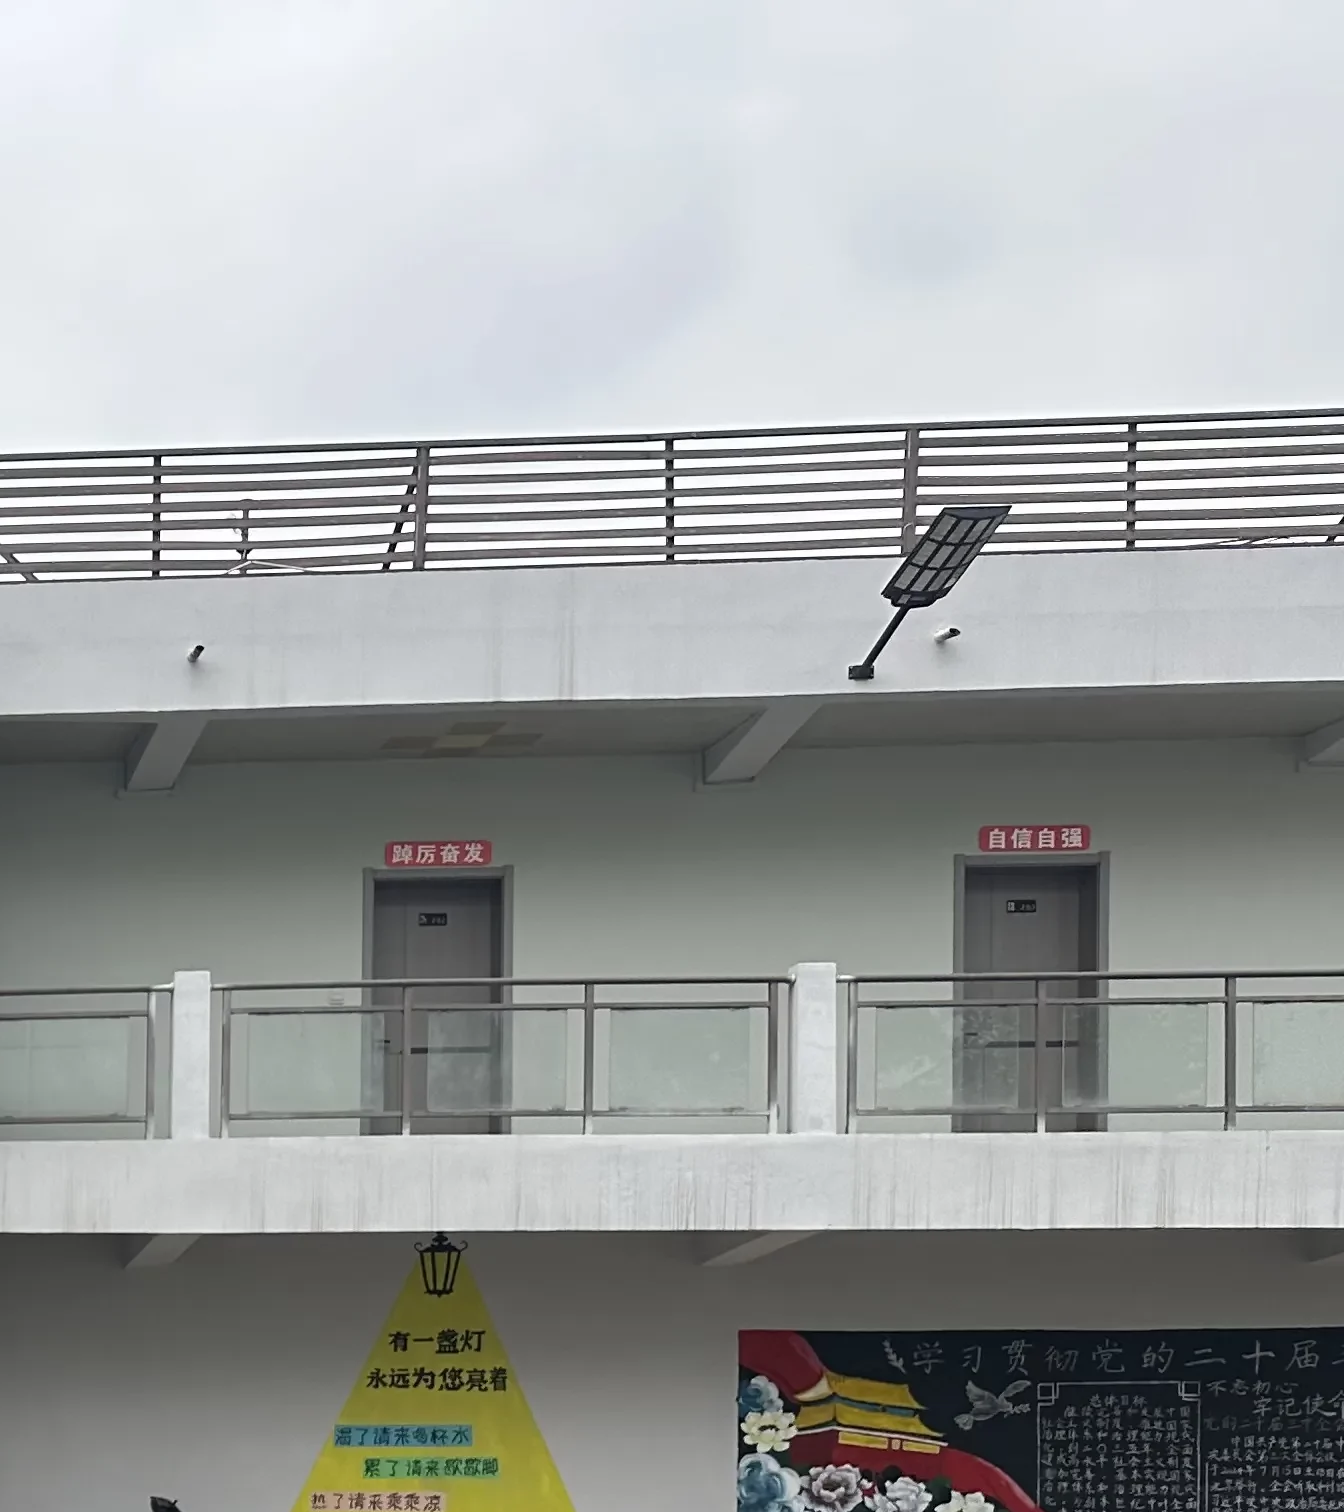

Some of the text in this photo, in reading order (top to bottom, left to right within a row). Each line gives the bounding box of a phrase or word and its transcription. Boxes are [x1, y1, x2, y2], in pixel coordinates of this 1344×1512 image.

[989, 828, 1083, 849] 自信自强
[392, 842, 484, 864] 踔厉奋发
[388, 1328, 486, 1354] 有一盏灯
[366, 1366, 508, 1392] 永远为您亮着
[1206, 1378, 1299, 1397] 不忘初心
[334, 1426, 470, 1446] 渴了请来喝杯水
[363, 1457, 499, 1478] 累了请来歇歇脚
[310, 1492, 443, 1512] 热了请来乘乘凉
